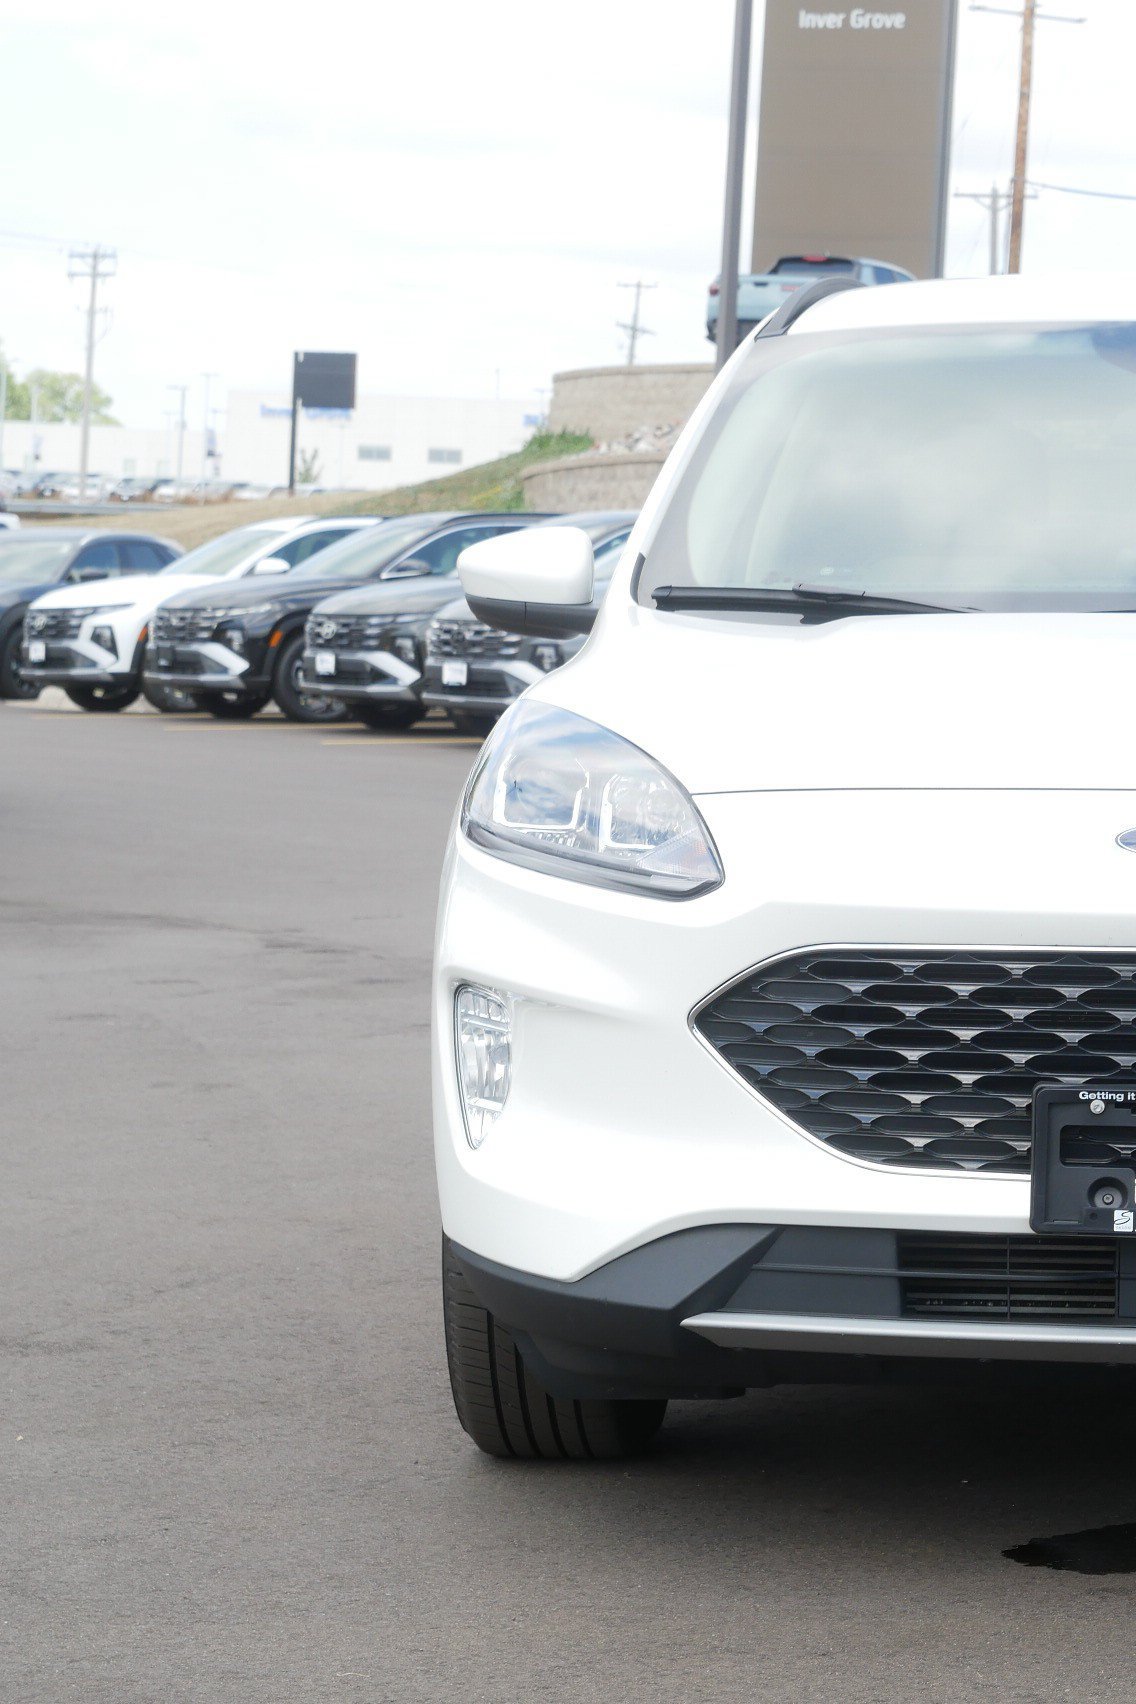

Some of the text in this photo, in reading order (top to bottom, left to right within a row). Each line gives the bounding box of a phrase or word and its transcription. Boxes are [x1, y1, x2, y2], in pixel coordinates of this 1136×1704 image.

[798, 7, 907, 29] Inver Grove
[1078, 1091, 1125, 1102] Getting
[1127, 1092, 1136, 1101] it
